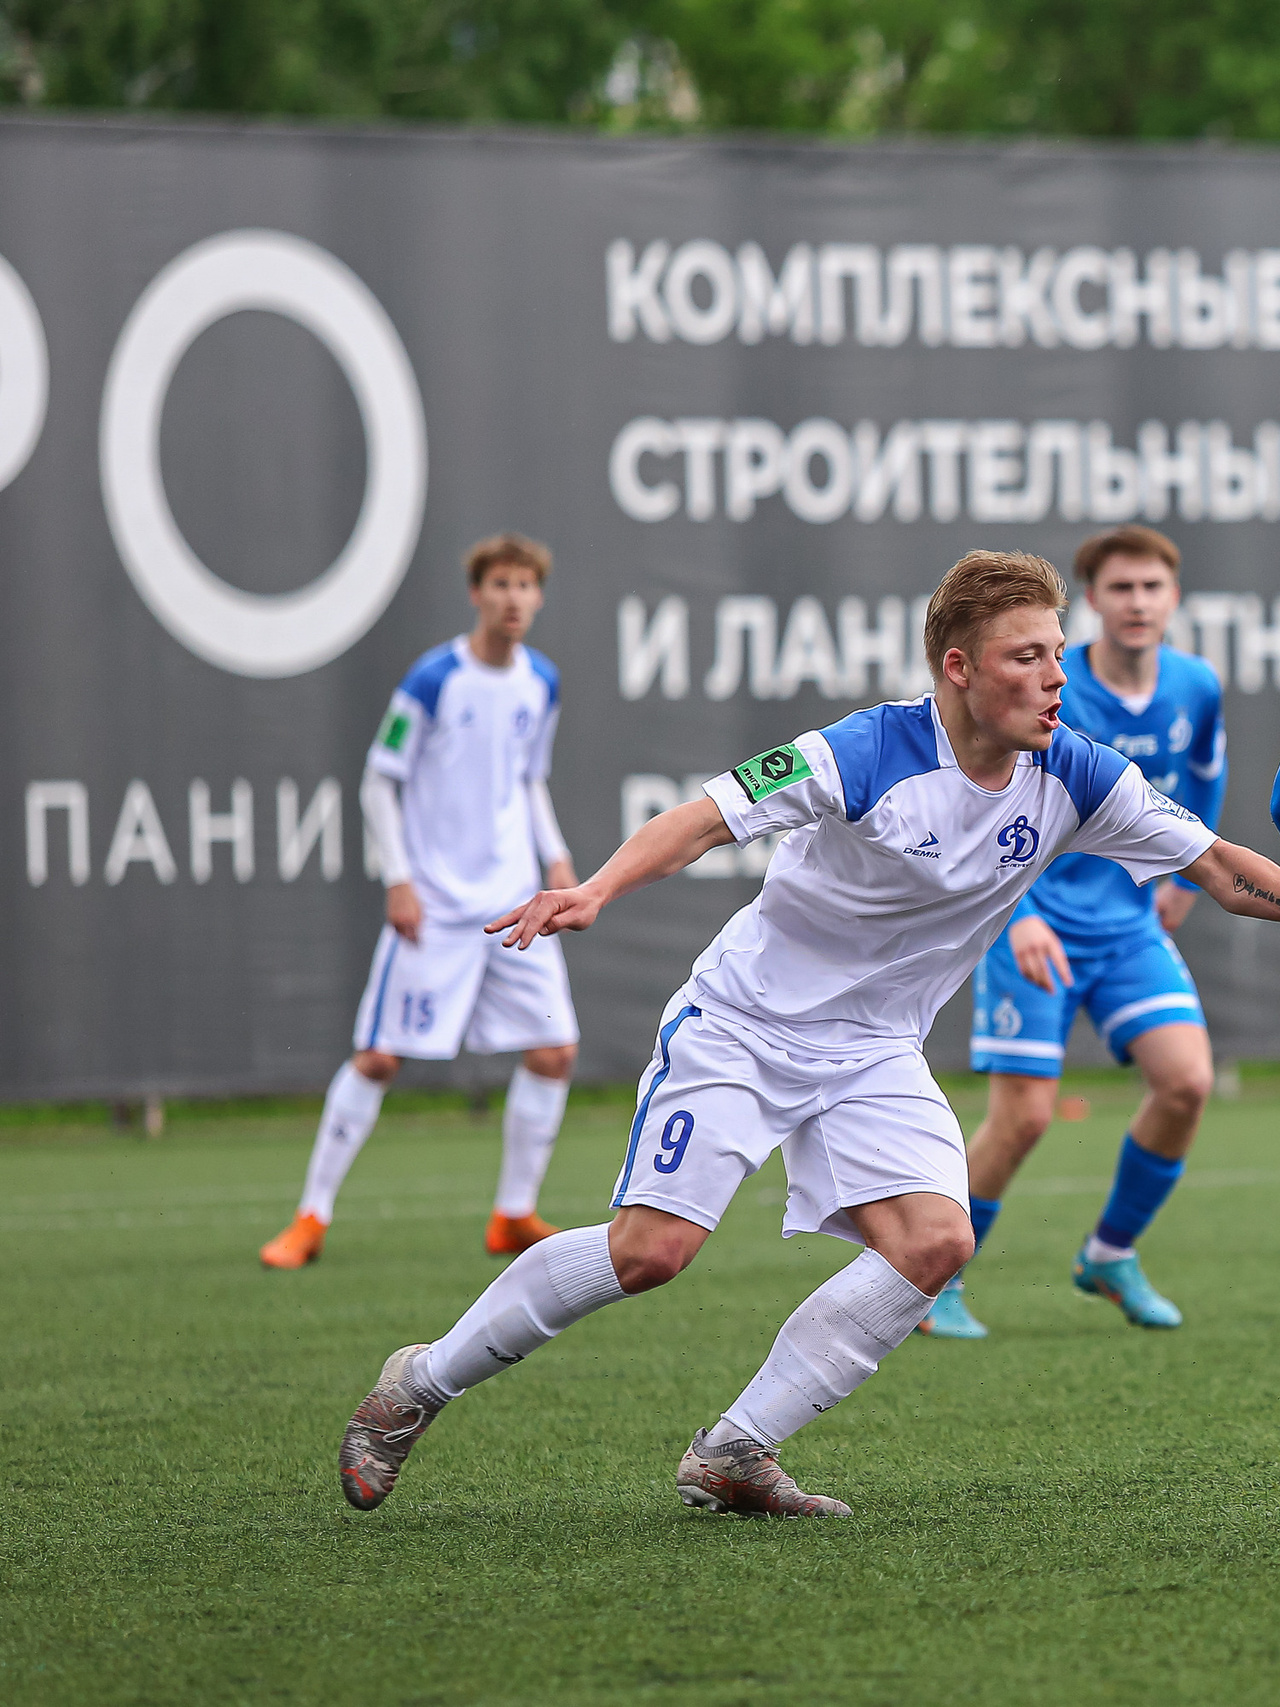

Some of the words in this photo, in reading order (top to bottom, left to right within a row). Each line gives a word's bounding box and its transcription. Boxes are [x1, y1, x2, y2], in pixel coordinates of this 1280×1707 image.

[617, 596, 690, 700] И
[765, 756, 787, 777] 2
[25, 776, 386, 888] ПАНИ
[903, 847, 942, 859] DEMIX
[402, 989, 435, 1034] 15
[654, 1110, 694, 1174] 9
